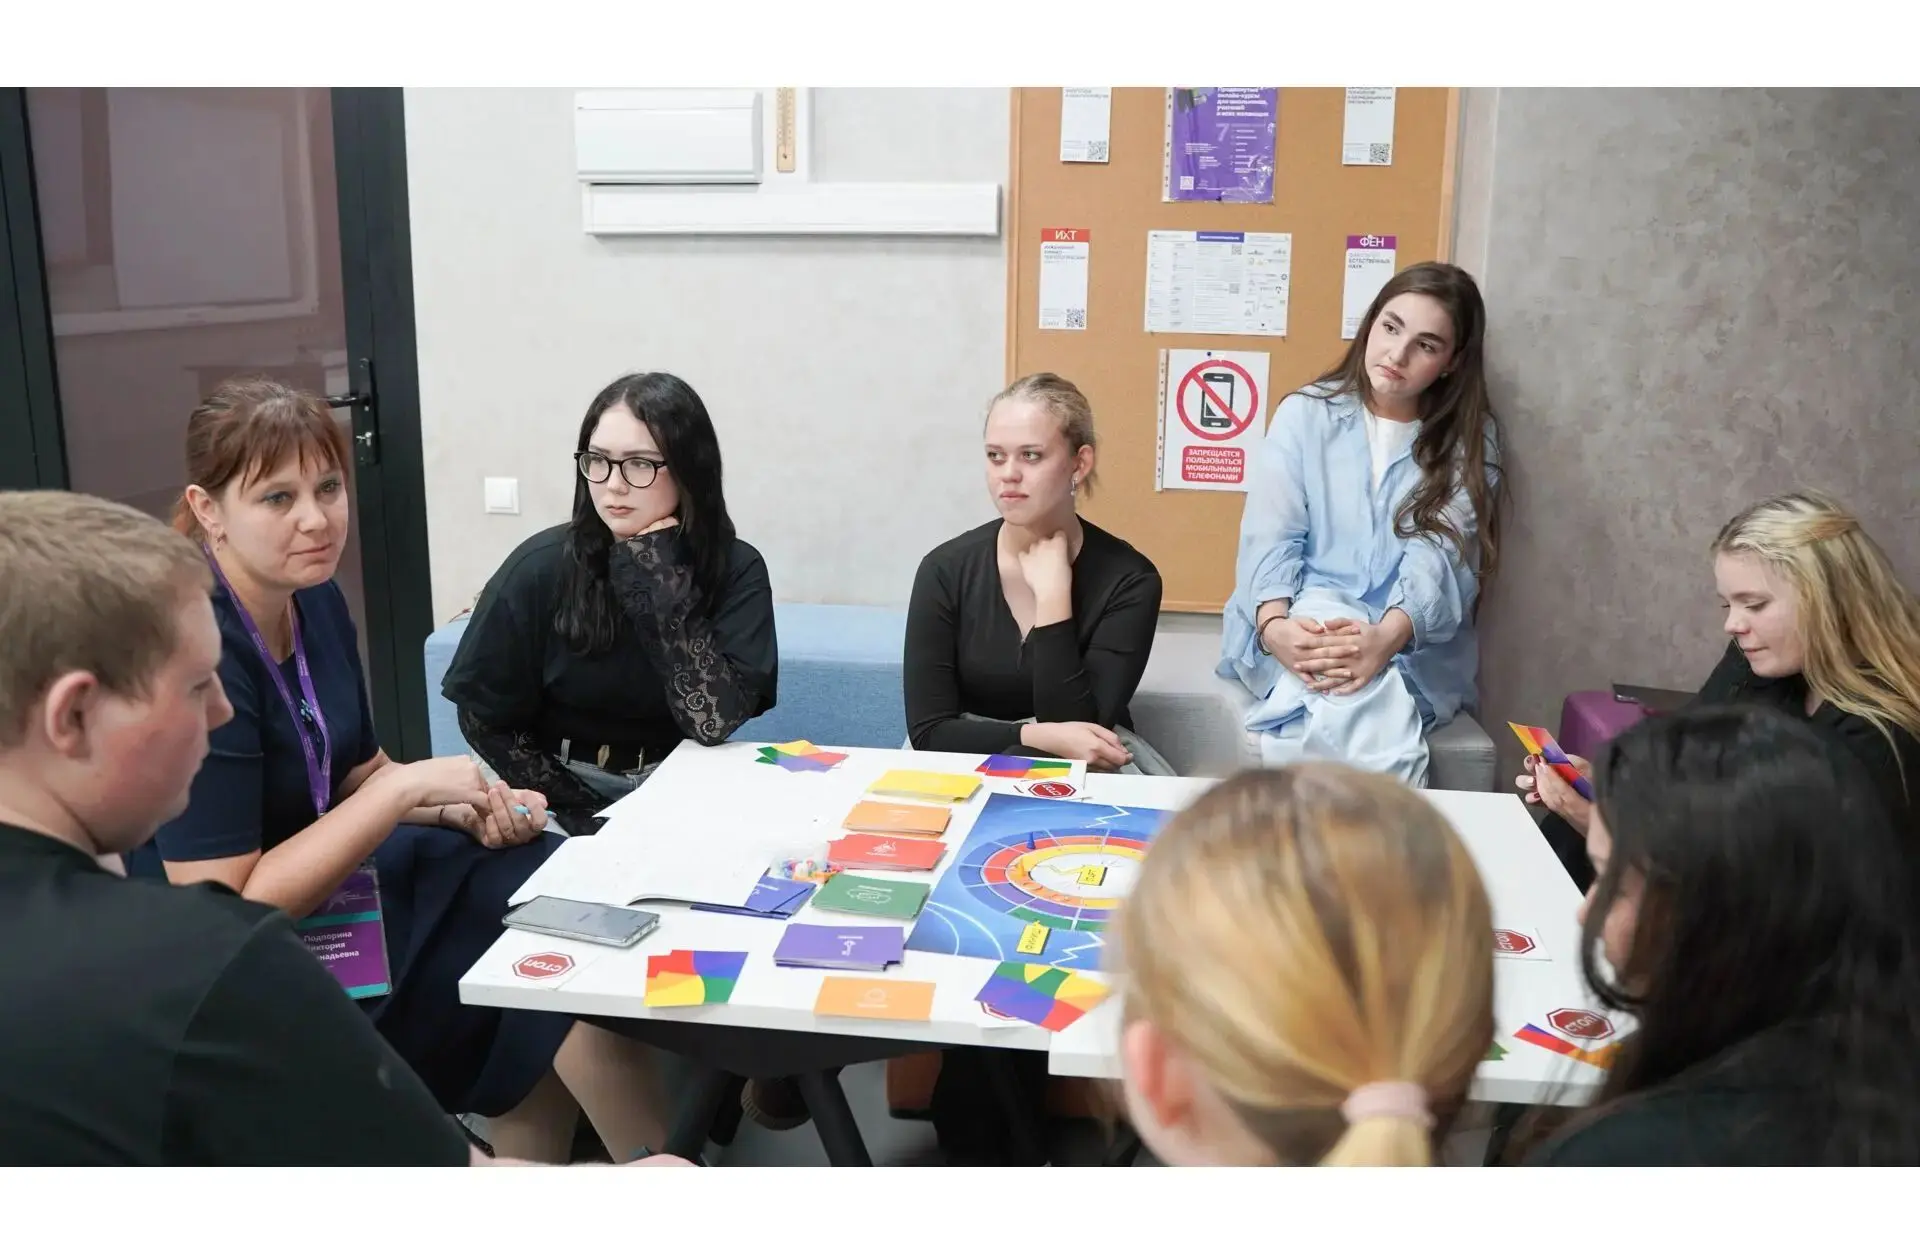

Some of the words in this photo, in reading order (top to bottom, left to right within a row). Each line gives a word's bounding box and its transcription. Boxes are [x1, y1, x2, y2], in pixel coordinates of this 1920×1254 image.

[1055, 230, 1077, 240] ИХТ
[1359, 236, 1385, 247] ФЕН
[1189, 449, 1240, 457] ЗАПРЕЩАЕТСЯ
[1186, 457, 1241, 465] ПОЛЬЗОВАТЬСЯ
[1186, 465, 1241, 473] МОБИЛЬНЫМИ
[303, 931, 353, 942] Подпорина
[1564, 1015, 1598, 1032] СТОП
